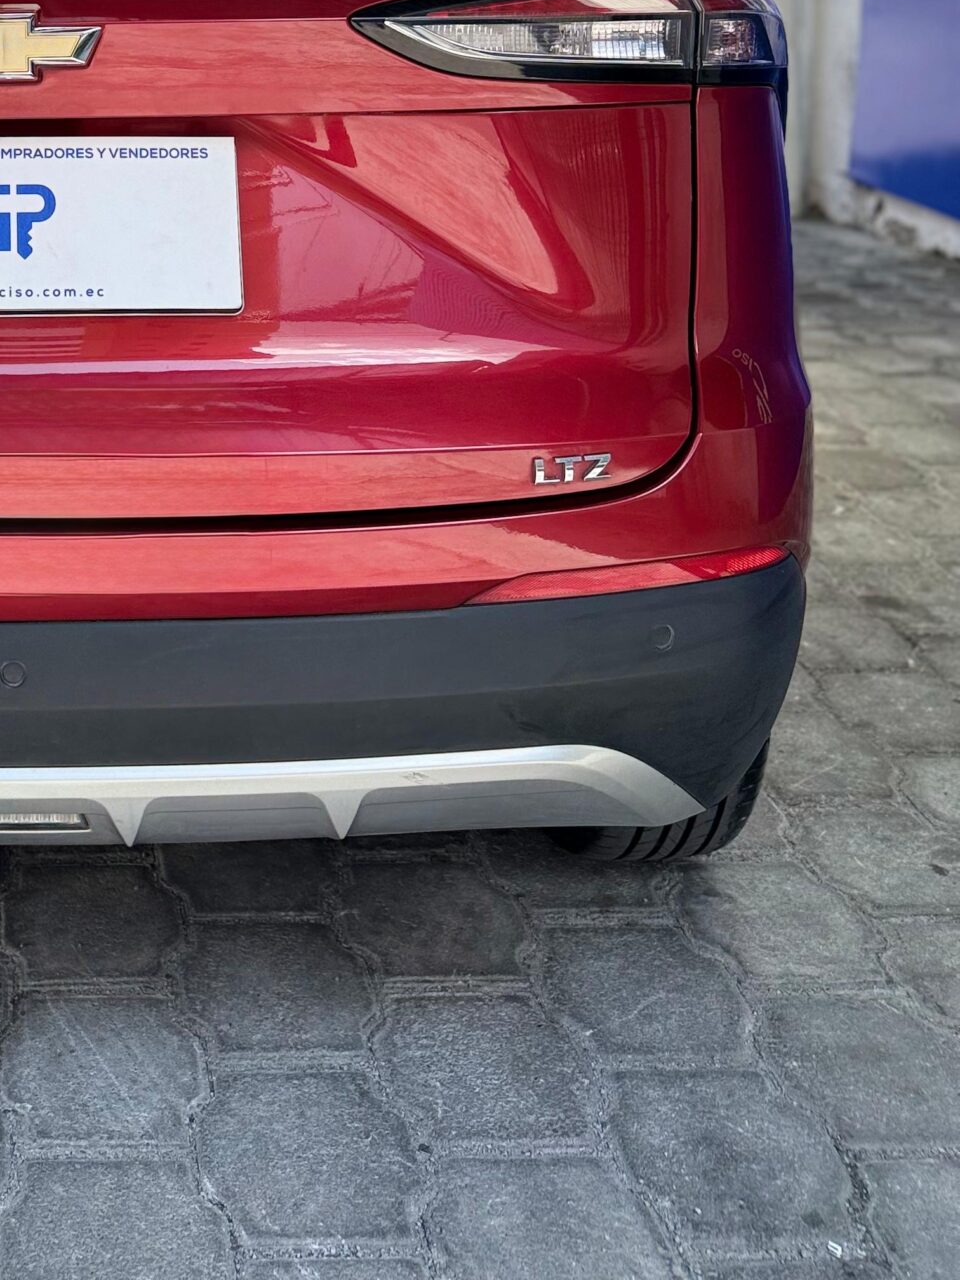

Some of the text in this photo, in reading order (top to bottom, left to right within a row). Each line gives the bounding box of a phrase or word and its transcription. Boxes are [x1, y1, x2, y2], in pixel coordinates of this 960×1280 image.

[96, 147, 107, 159] Y
[108, 147, 209, 159] VENDEDORES
[534, 452, 612, 485] LTZ
